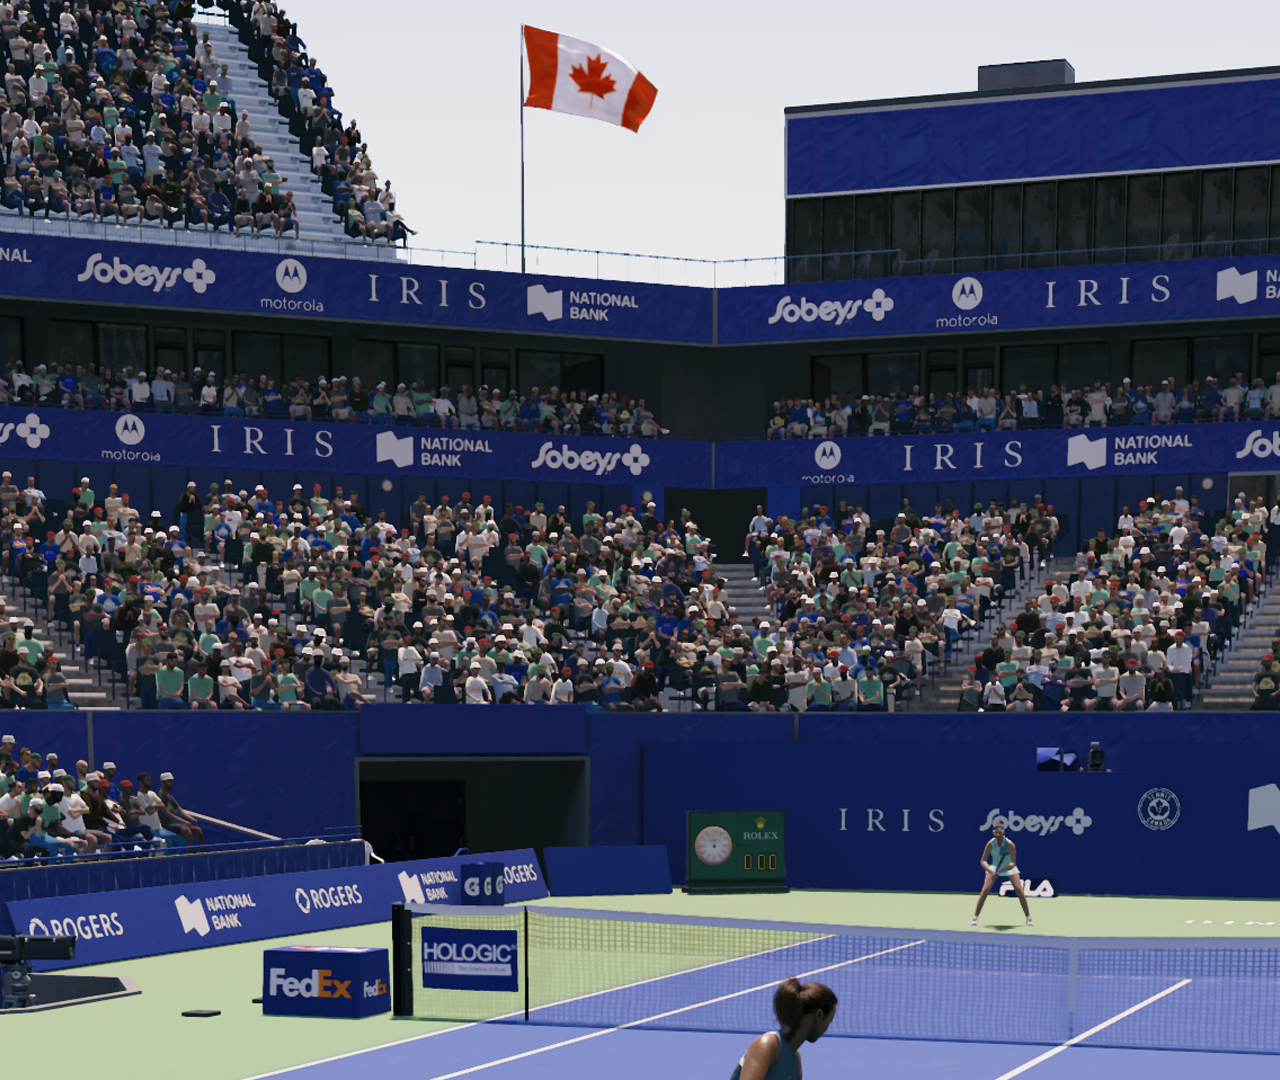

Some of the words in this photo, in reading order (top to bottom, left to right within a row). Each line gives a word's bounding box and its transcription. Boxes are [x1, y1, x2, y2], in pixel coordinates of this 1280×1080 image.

[78, 253, 182, 292] Sobeys
[369, 275, 485, 308] IRIS
[570, 291, 639, 308] NATIONAL
[1046, 275, 1169, 308] IRIS
[261, 297, 323, 312] motorola
[570, 307, 608, 321] BANK
[768, 296, 862, 325] Sobeys
[936, 313, 997, 327] motorola
[211, 425, 333, 457] IRIS
[421, 437, 492, 452] NATIONAL
[1115, 435, 1192, 449] NATIONAL
[421, 453, 461, 466] BANK
[532, 442, 621, 475] Sobeys
[904, 441, 1022, 470] IRIS
[1114, 451, 1157, 465] BANK
[840, 809, 944, 832] IRIS
[743, 831, 779, 840] ROLEX
[420, 871, 457, 885] NATIONAL
[503, 864, 537, 884] OGERS
[205, 893, 256, 911] NATIONAL
[310, 884, 362, 909] ROGERS
[426, 887, 448, 901] BANK
[50, 912, 123, 940] ROGERS
[212, 913, 241, 930] BANK
[269, 967, 353, 999] FedEx
[363, 978, 388, 999] FedEx
